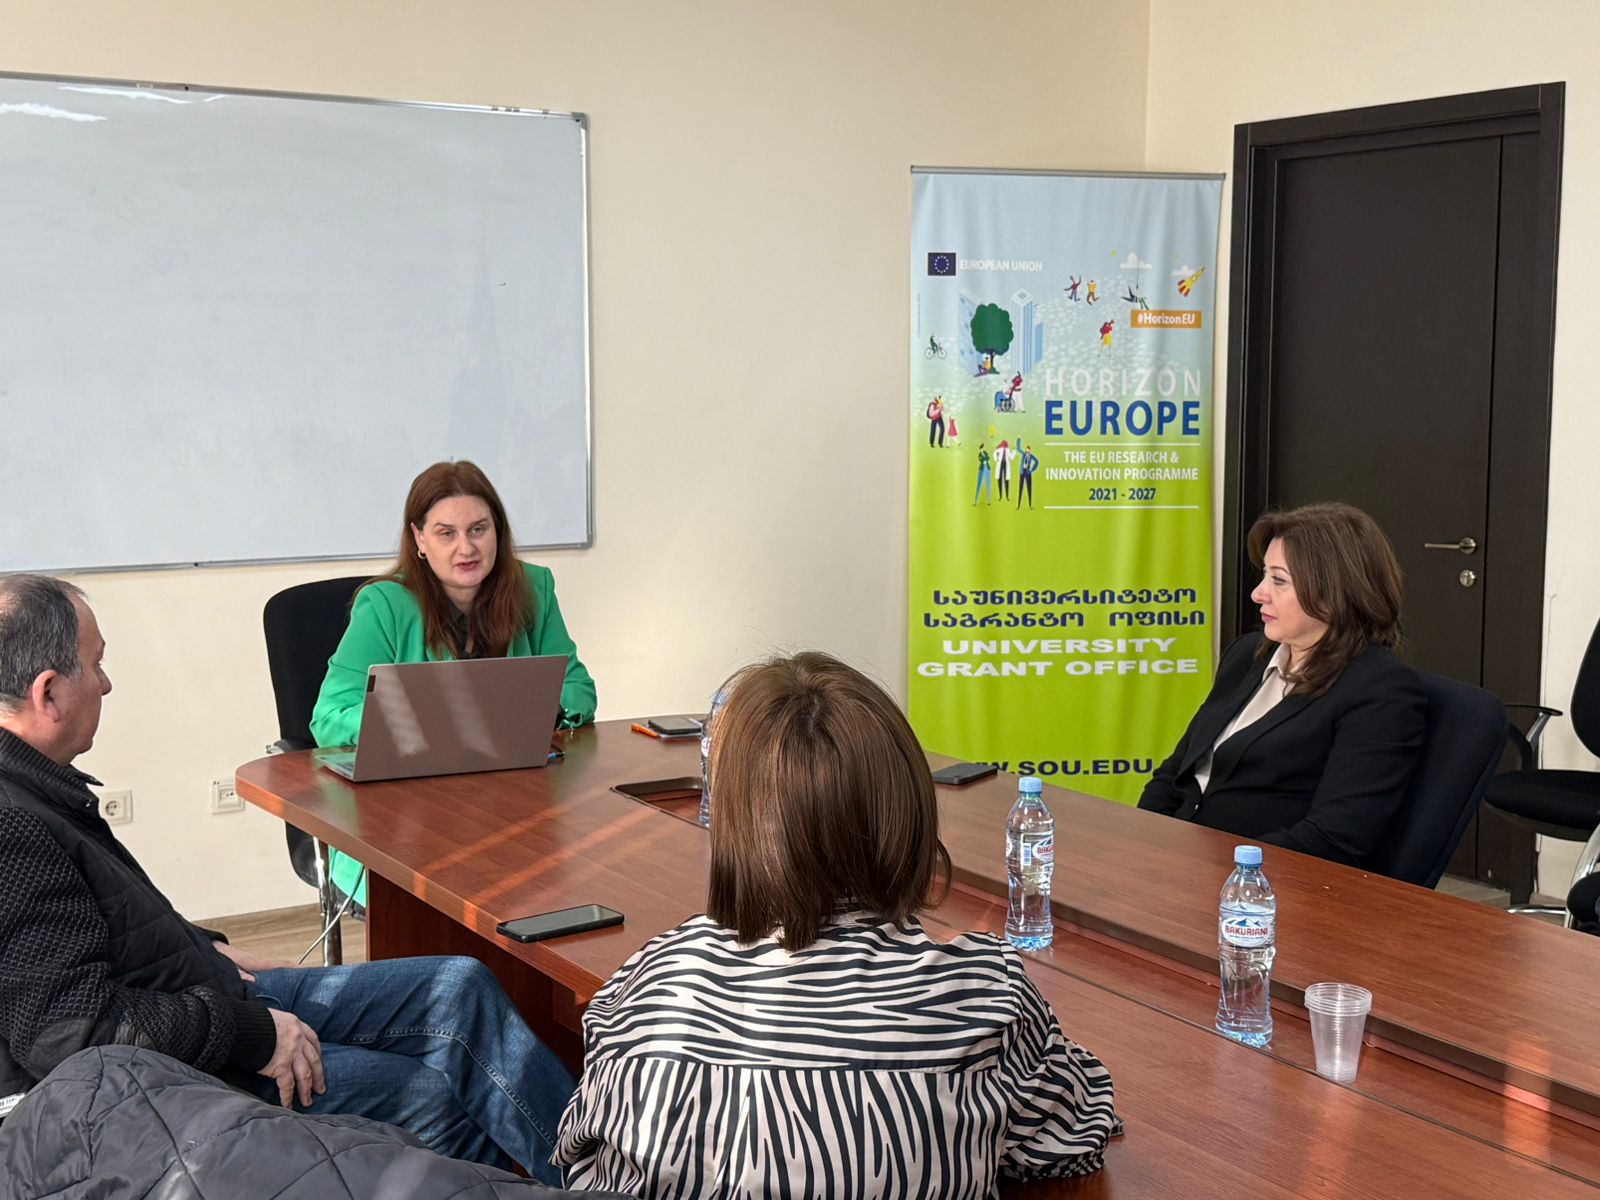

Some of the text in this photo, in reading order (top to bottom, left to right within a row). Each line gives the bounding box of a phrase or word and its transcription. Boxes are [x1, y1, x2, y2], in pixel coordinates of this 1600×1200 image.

[960, 259, 1043, 272] EUROPEAN UNION
[1137, 313, 1195, 325] #HorizonEU
[1045, 368, 1201, 397] HORIZON
[1045, 400, 1200, 436] EUROPE
[1064, 451, 1180, 463] THE EU RESEARCH &
[1045, 467, 1199, 480] INNOVATION PROGRAMME
[1089, 488, 1118, 501] 2021
[1129, 488, 1156, 500] 2027
[933, 588, 1196, 605] საუნივერსიტეტო
[923, 610, 1205, 628] საგრანტო ოფისი
[942, 638, 1176, 655] UNIVERSITY
[917, 660, 1198, 677] GRANT OFFICE
[1225, 925, 1267, 935] BAKURIANI
